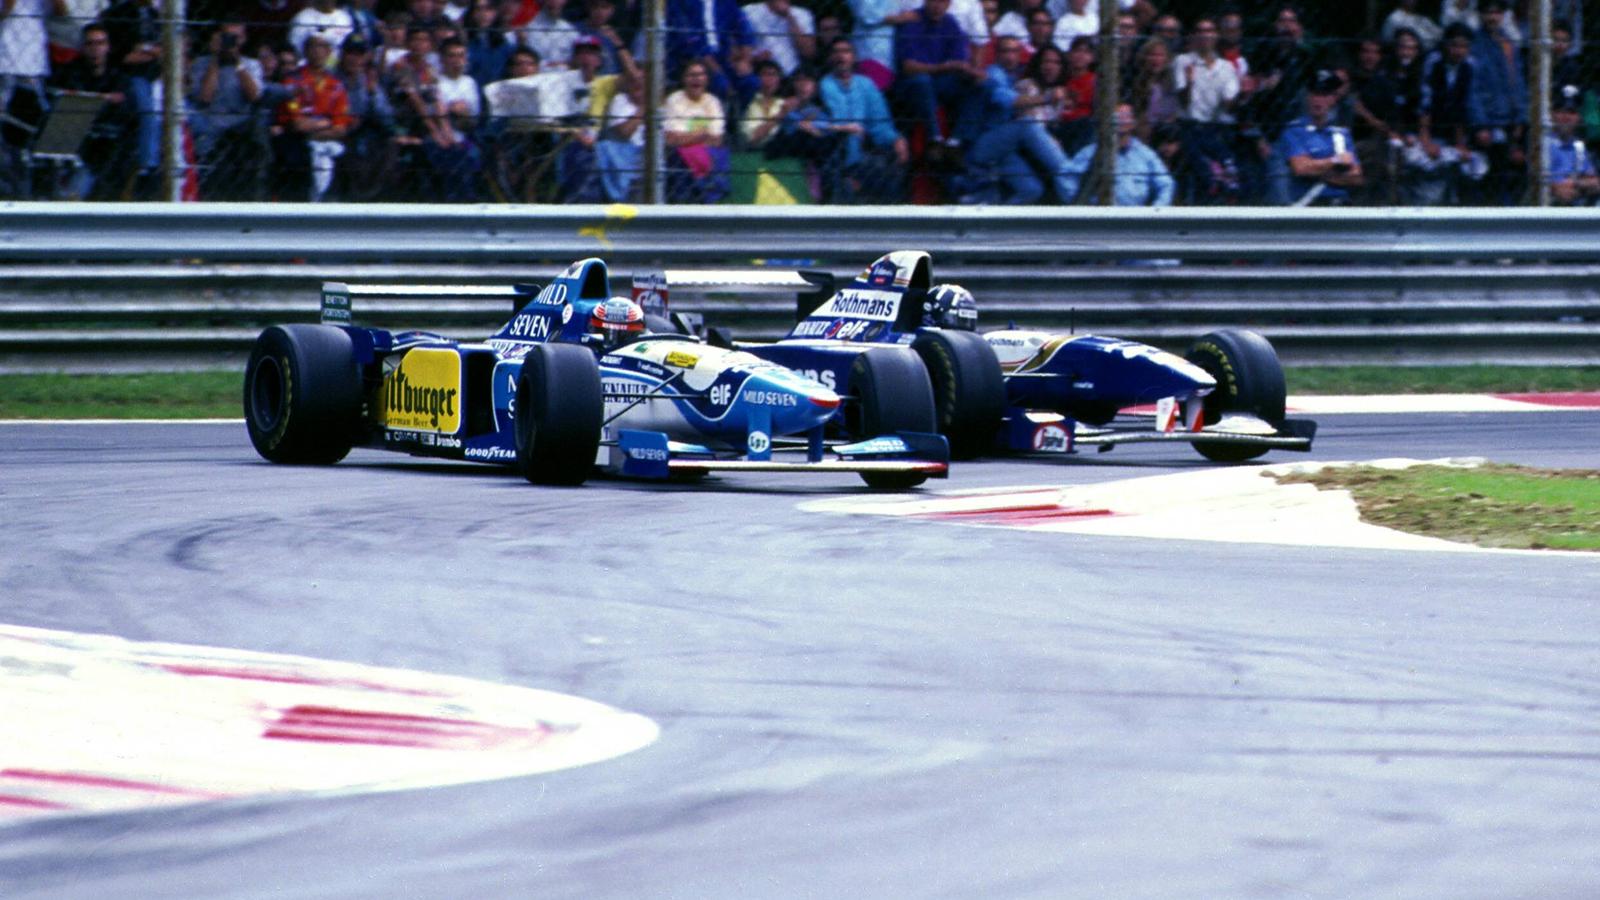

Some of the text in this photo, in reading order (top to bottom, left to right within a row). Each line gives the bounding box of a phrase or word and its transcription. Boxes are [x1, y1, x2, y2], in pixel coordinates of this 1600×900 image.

[830, 291, 894, 317] Rothmans
[509, 314, 551, 338] SEVEN
[836, 320, 869, 340] elf
[601, 382, 647, 396] ENAULT
[710, 384, 731, 405] elf
[766, 392, 798, 407] SEVEN
